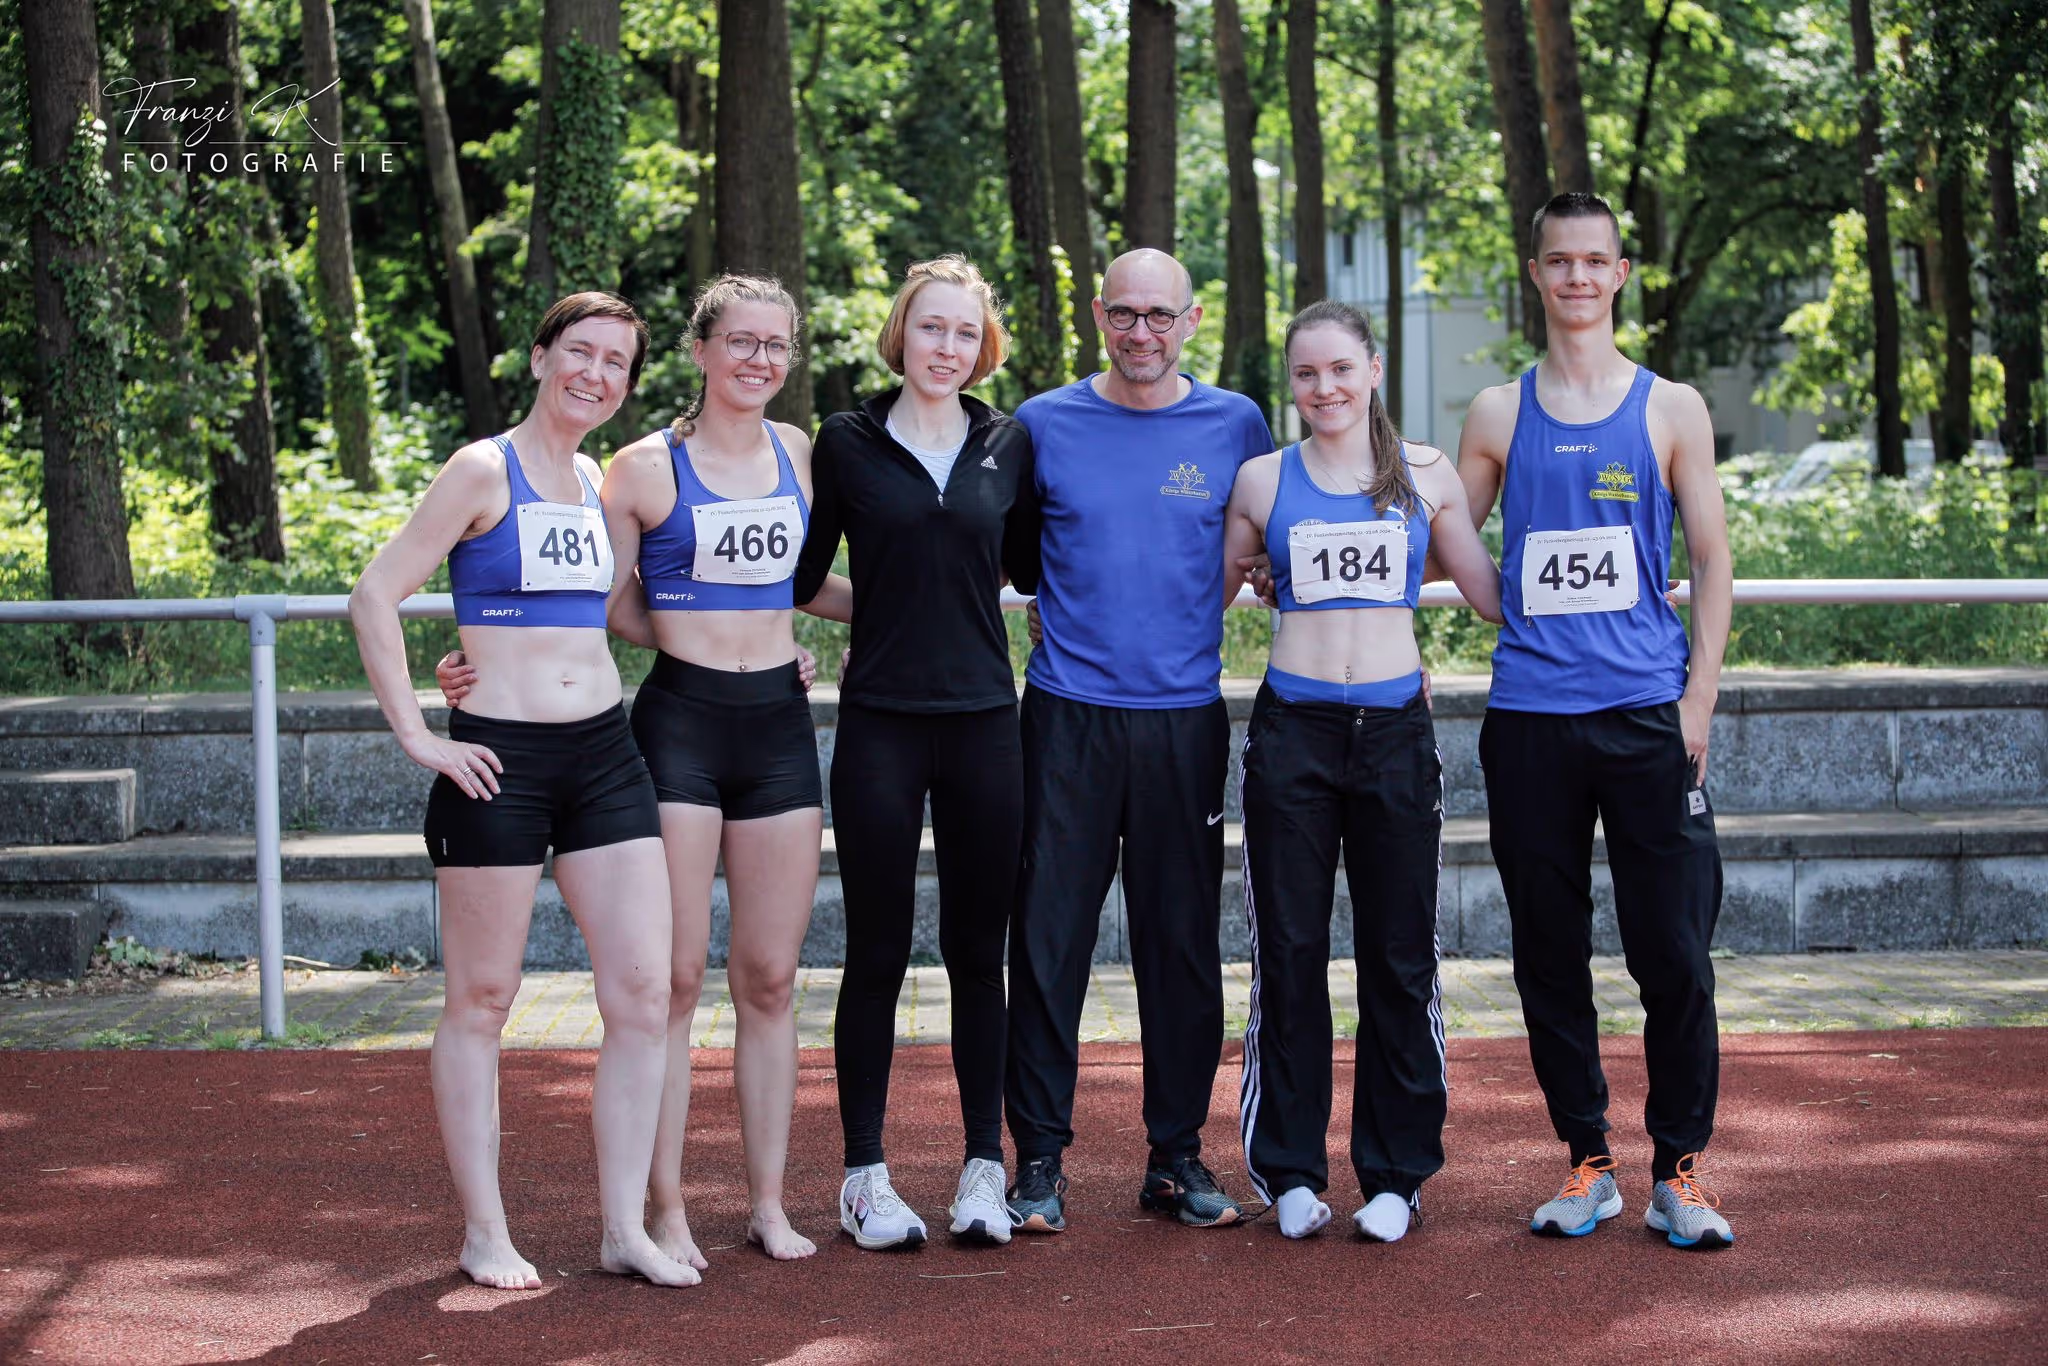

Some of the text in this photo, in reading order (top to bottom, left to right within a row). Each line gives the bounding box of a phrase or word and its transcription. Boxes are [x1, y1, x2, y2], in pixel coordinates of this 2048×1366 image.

[1554, 445, 1588, 453] CRAFT
[539, 527, 600, 567] 481
[713, 521, 789, 563] 466
[1312, 544, 1391, 582] 184
[1538, 550, 1620, 591] 454
[656, 593, 687, 601] CRAFT
